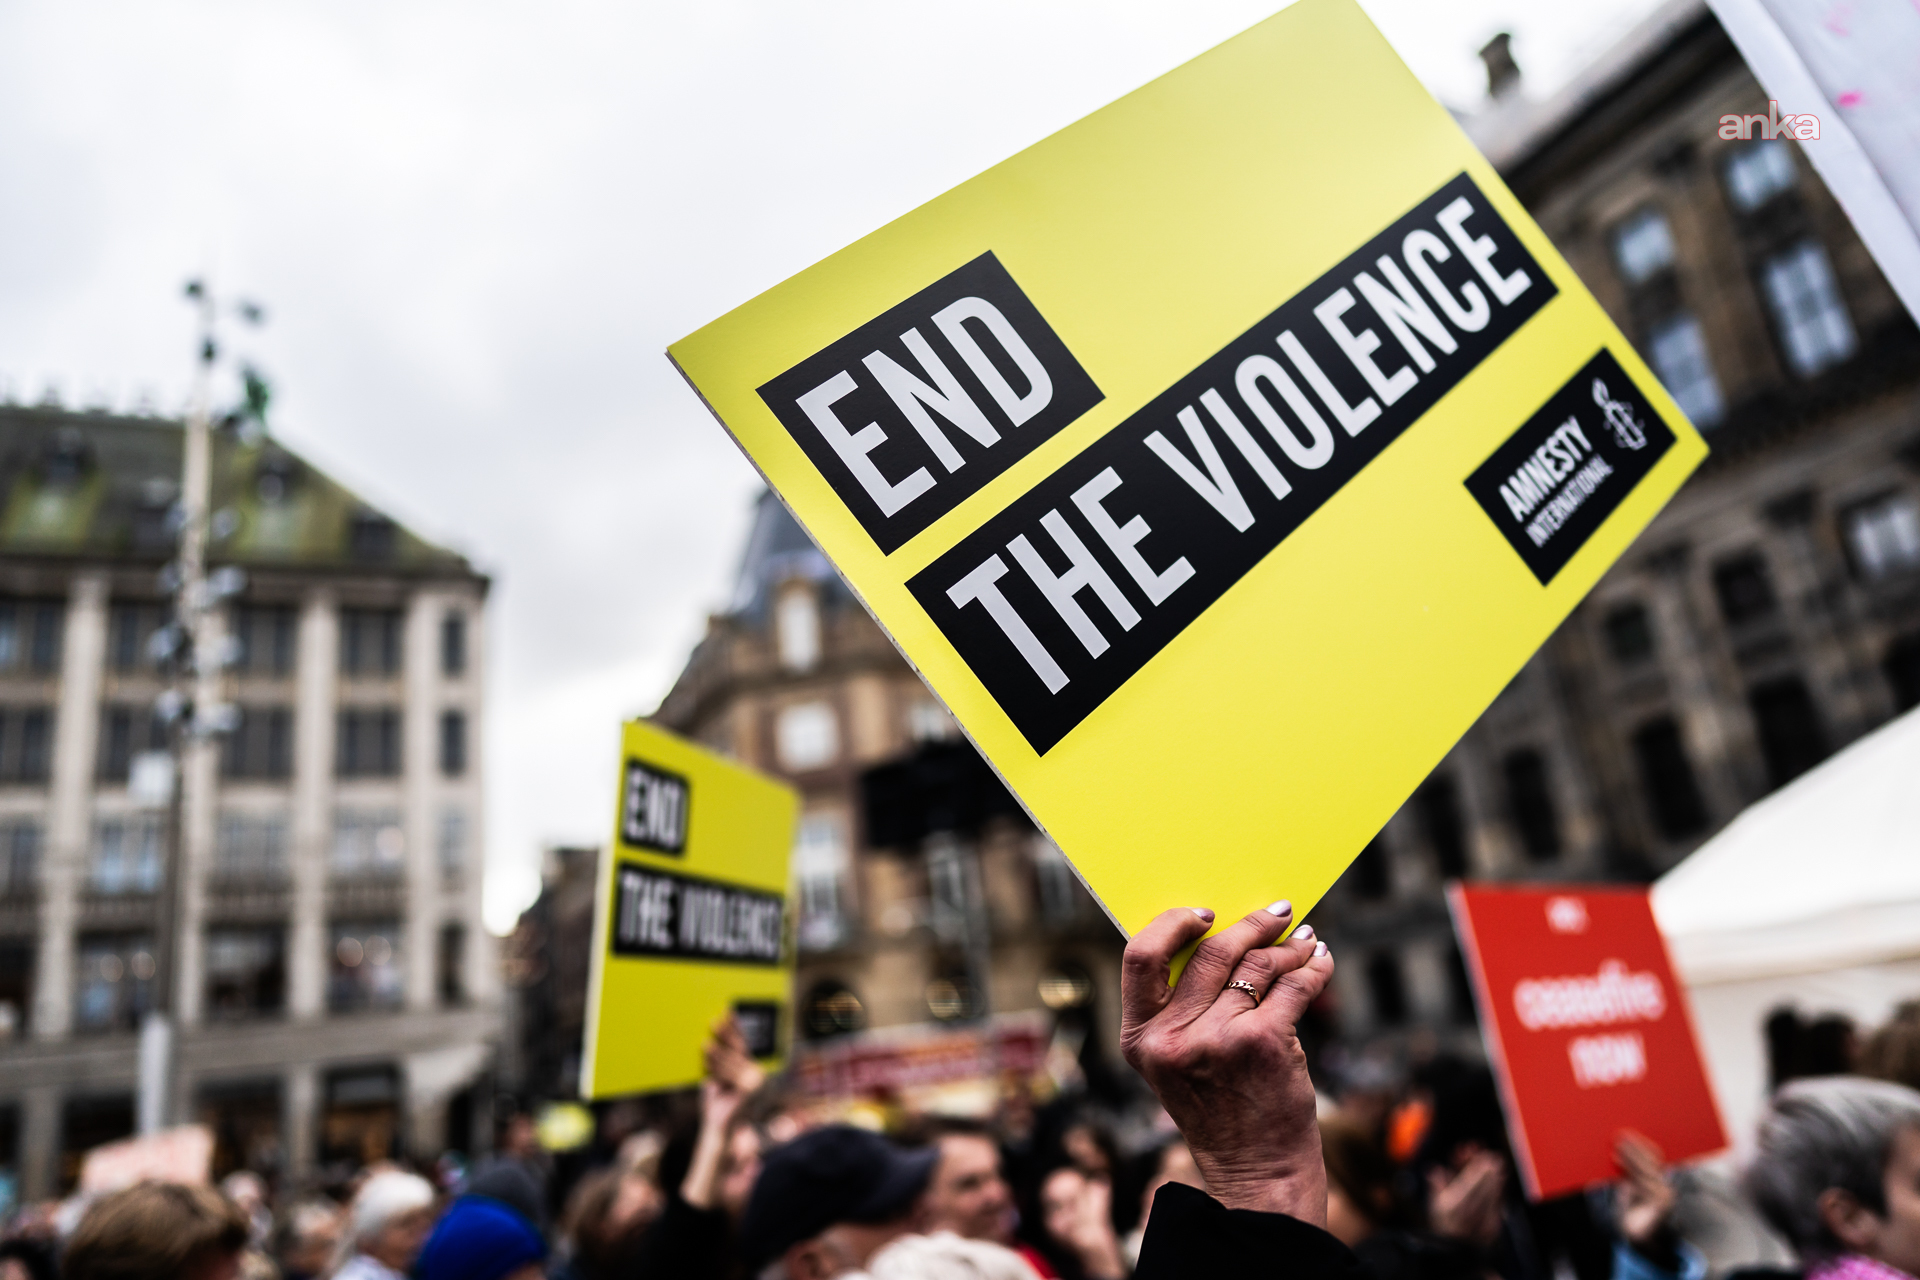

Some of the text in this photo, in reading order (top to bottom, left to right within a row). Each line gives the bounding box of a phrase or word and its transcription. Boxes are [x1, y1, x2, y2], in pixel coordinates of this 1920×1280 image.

[794, 296, 1054, 519] END
[945, 195, 1532, 696] THE VIOLENCE
[1498, 414, 1593, 524] AMNESTY
[1524, 453, 1615, 548] INTERNATIONAL
[624, 766, 686, 847] END
[618, 869, 675, 950] THE
[1569, 1032, 1647, 1089] now
